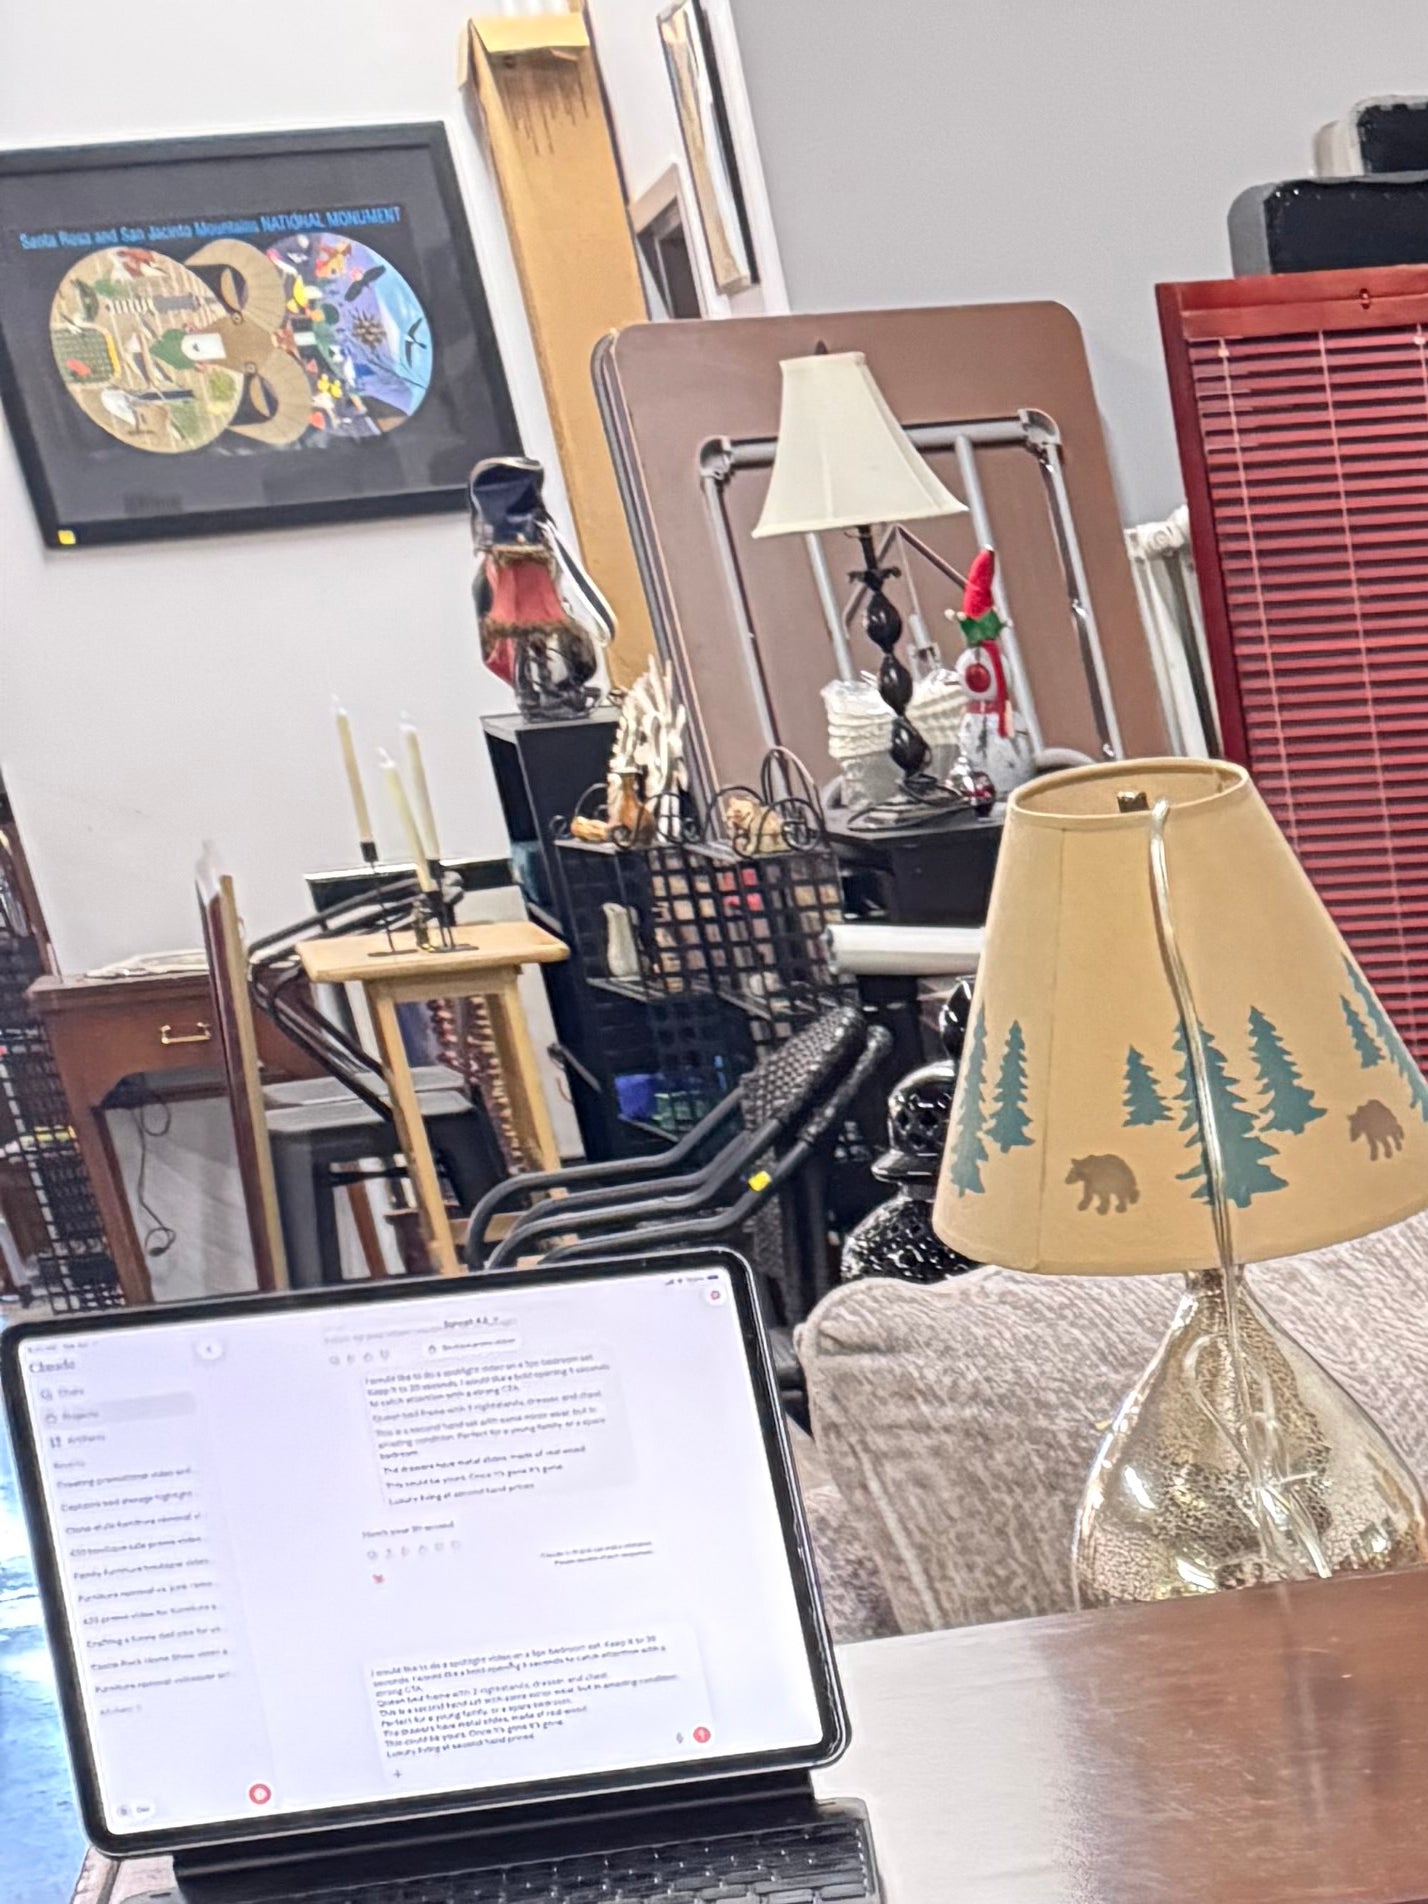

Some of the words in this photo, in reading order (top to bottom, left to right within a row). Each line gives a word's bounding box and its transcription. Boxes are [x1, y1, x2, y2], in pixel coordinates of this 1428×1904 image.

[20, 232, 58, 249] Santa
[94, 228, 118, 243] and
[119, 226, 145, 242] San
[260, 211, 325, 231] NATIONAL
[326, 206, 400, 226] MONUMENT
